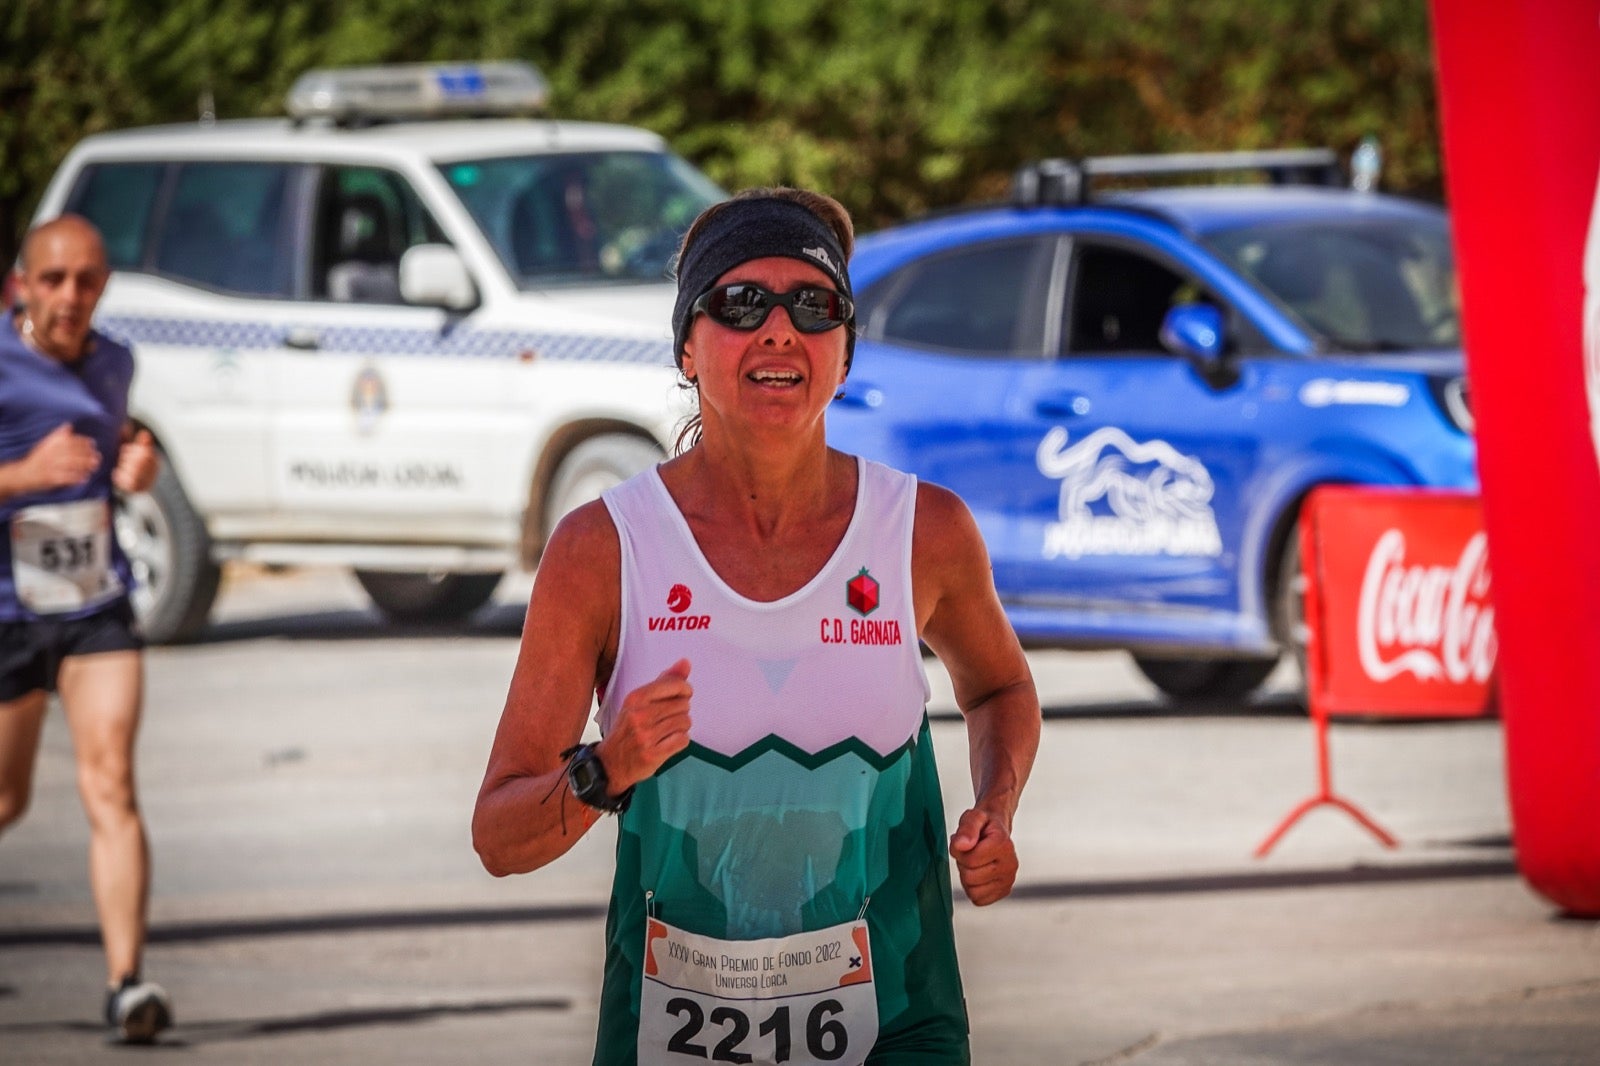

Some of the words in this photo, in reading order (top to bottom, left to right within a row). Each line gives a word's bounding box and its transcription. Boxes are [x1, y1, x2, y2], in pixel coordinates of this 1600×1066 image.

[41, 536, 94, 572] 531
[648, 615, 711, 632] VIATOR
[820, 618, 847, 644] C.D.
[850, 619, 902, 646] GARNATA
[668, 941, 690, 963] XXXV
[692, 949, 717, 969] GRAN
[721, 954, 760, 972] PREMIO
[815, 941, 842, 964] 2022
[715, 973, 758, 989] UNIVERSO
[760, 974, 788, 989] LORCA
[666, 997, 848, 1065] 2216
